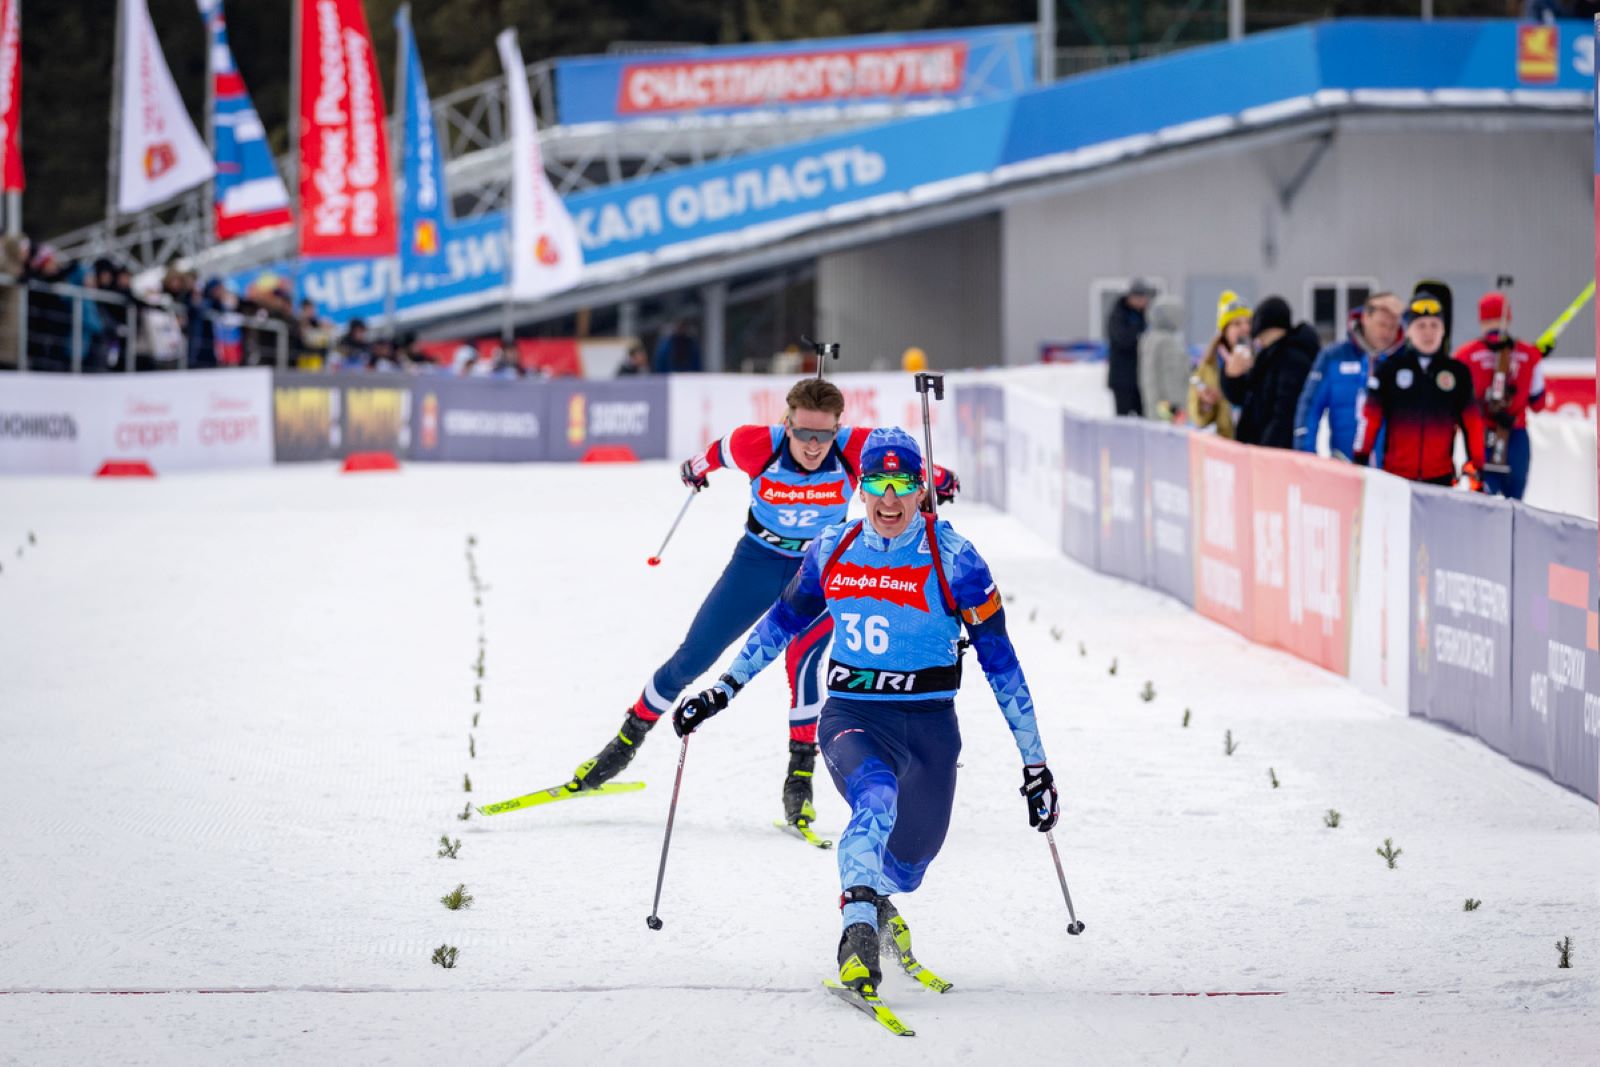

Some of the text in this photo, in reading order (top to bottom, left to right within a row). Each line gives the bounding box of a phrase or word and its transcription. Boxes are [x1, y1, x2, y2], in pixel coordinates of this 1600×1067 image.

[313, 128, 351, 236] Кубок
[667, 146, 885, 228] ОБЛАСТЬ
[763, 488, 837, 501] Альфа Банк
[778, 509, 819, 527] 32
[829, 573, 918, 593] Альфа Банк
[840, 612, 890, 655] 36
[828, 665, 916, 691] PARI
